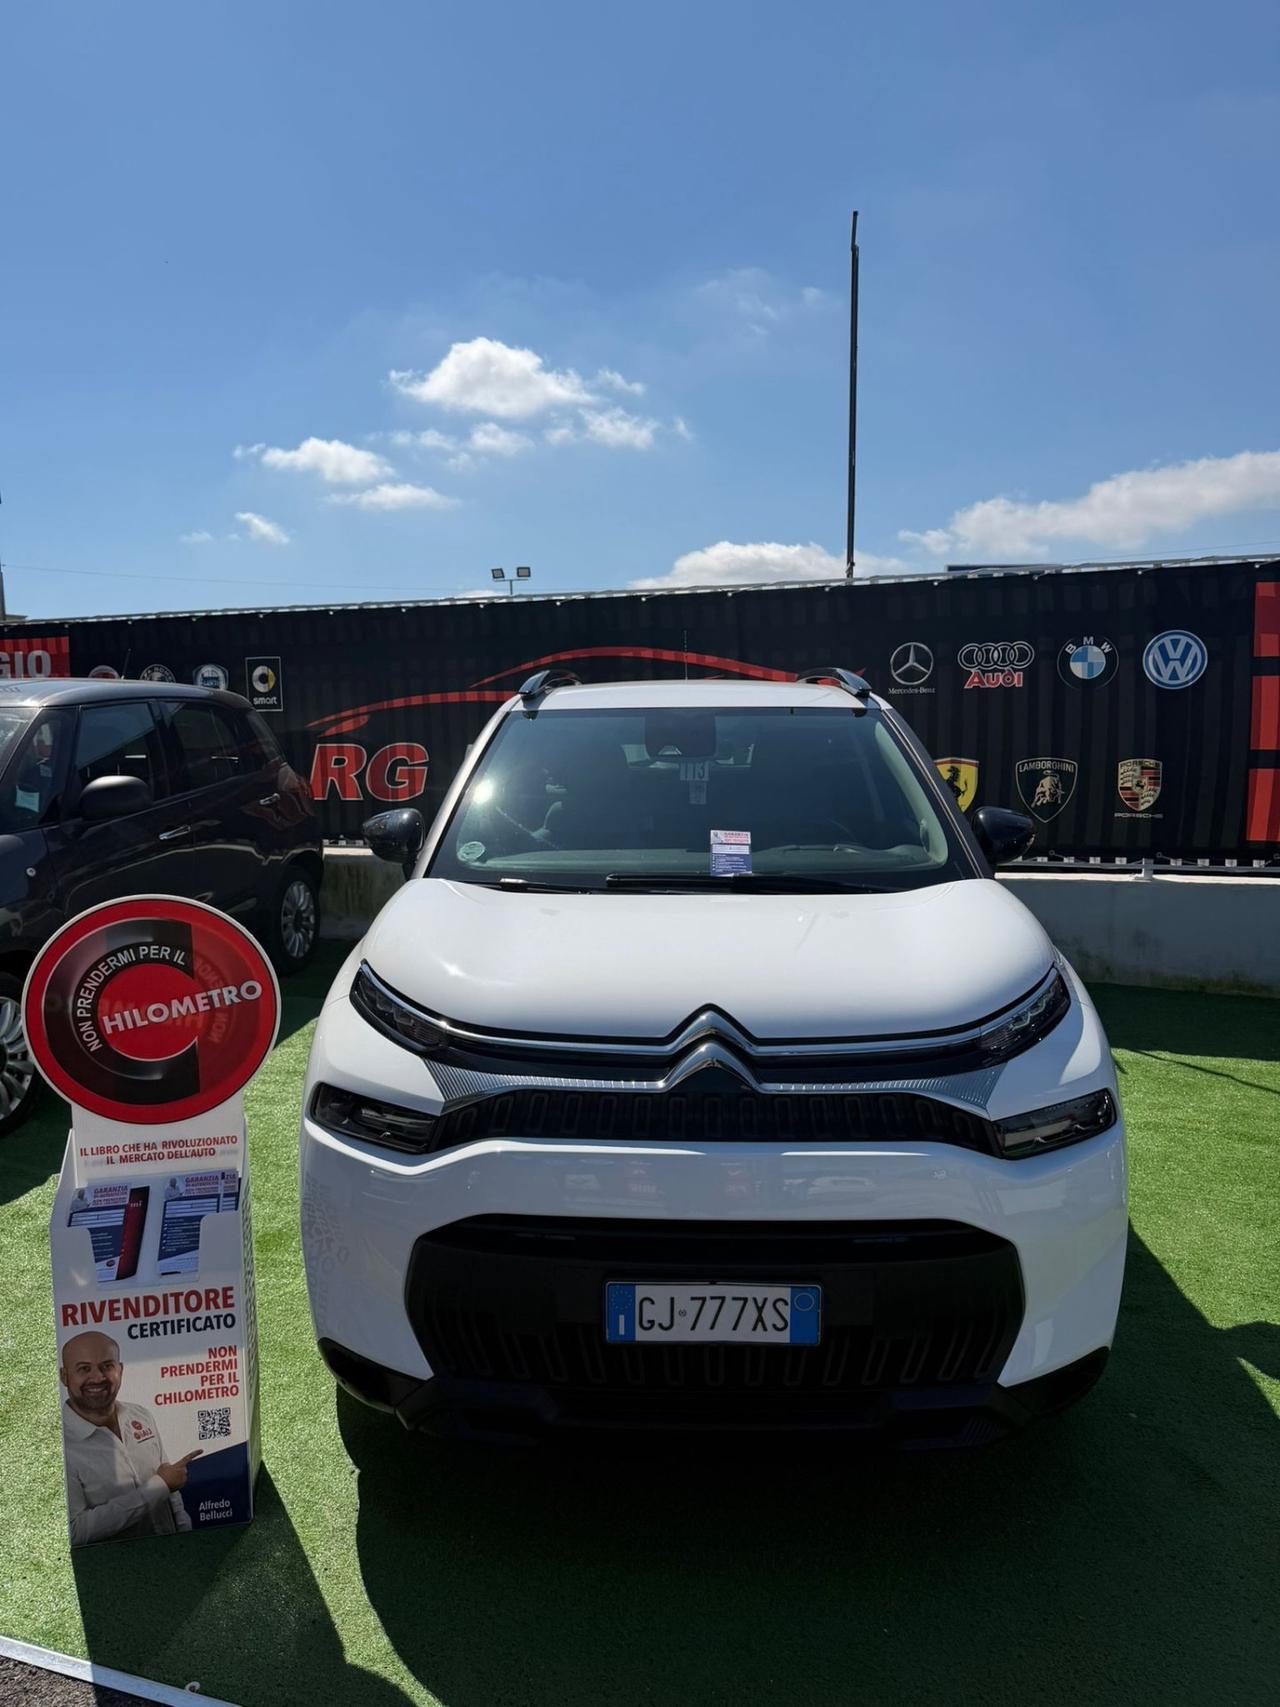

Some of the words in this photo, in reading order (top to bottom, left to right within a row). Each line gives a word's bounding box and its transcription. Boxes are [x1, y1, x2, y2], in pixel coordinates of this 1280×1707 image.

[1065, 636, 1112, 655] BMW
[253, 696, 277, 705] smart
[309, 742, 430, 801] RG
[1019, 760, 1074, 773] LAMBORGHINI
[139, 945, 171, 960] PER
[173, 950, 187, 966] IL
[77, 948, 136, 1017] PRENDERMI
[102, 980, 262, 1035] HILOMETRO
[80, 1021, 103, 1052] NON
[80, 1148, 89, 1157] IL
[91, 1145, 120, 1155] LIBRO
[122, 1143, 142, 1153] CHE
[144, 1141, 158, 1151] HA
[161, 1135, 238, 1149] RIVOLUZIONATO
[106, 1156, 115, 1165] IL
[119, 1152, 165, 1164] MERCATO
[167, 1147, 216, 1160] DELL'AUTO
[61, 1286, 235, 1327] RIVENDITORE
[127, 1313, 236, 1340] CERTIFICATO
[208, 1345, 237, 1360] NON
[160, 1358, 238, 1378] PRENDERMI
[200, 1373, 225, 1387] PER
[228, 1371, 240, 1384] IL
[154, 1385, 239, 1406] CHILOMETRO
[199, 1499, 231, 1512] Alfredo
[200, 1509, 233, 1522] Bellucci
